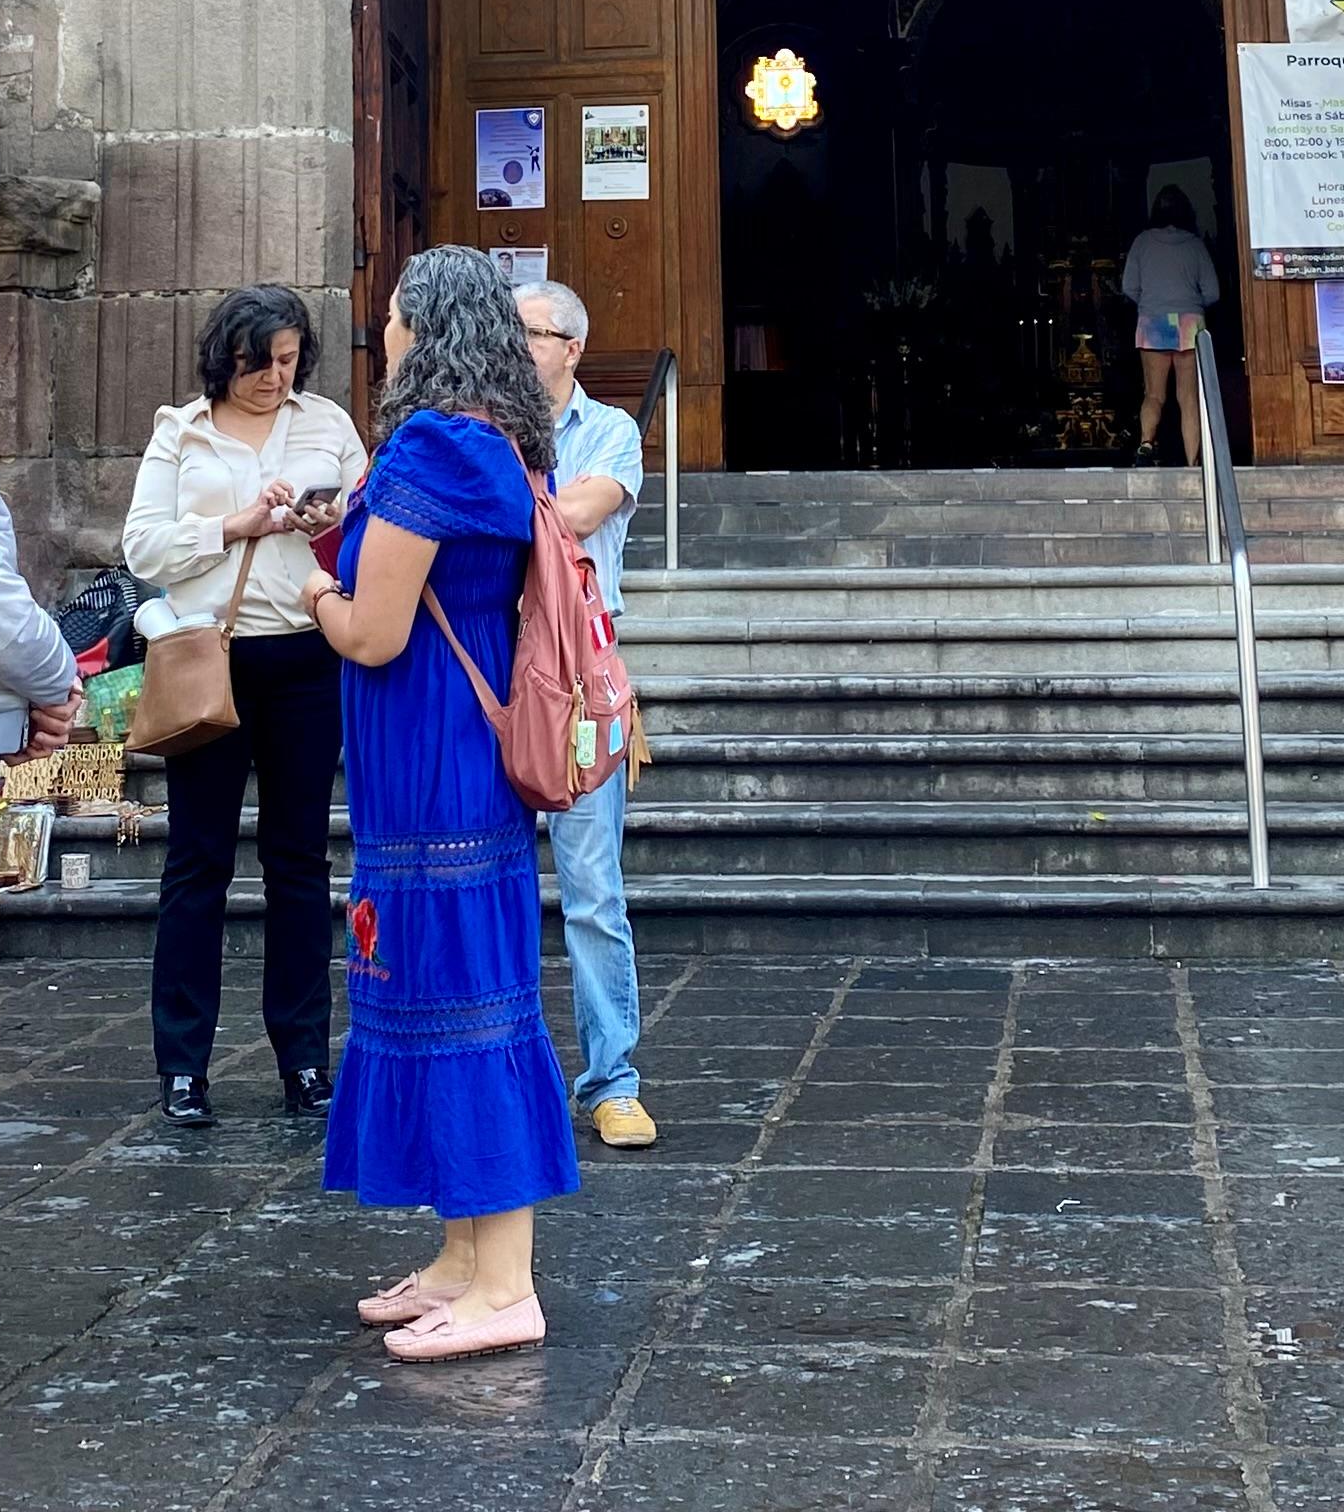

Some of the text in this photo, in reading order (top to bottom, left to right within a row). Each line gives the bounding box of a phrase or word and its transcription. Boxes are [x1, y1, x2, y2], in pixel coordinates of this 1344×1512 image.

[1280, 98, 1312, 108] Misas
[1278, 112, 1312, 121] Lunes
[1267, 125, 1313, 135] Monday
[1316, 125, 1327, 133] to
[1295, 137, 1323, 147] 12:00
[1325, 139, 1332, 148] y
[1304, 209, 1334, 218] 10:00
[1338, 210, 1344, 218] a
[64, 749, 123, 761] SERENIDAD
[62, 768, 94, 786] VALOR
